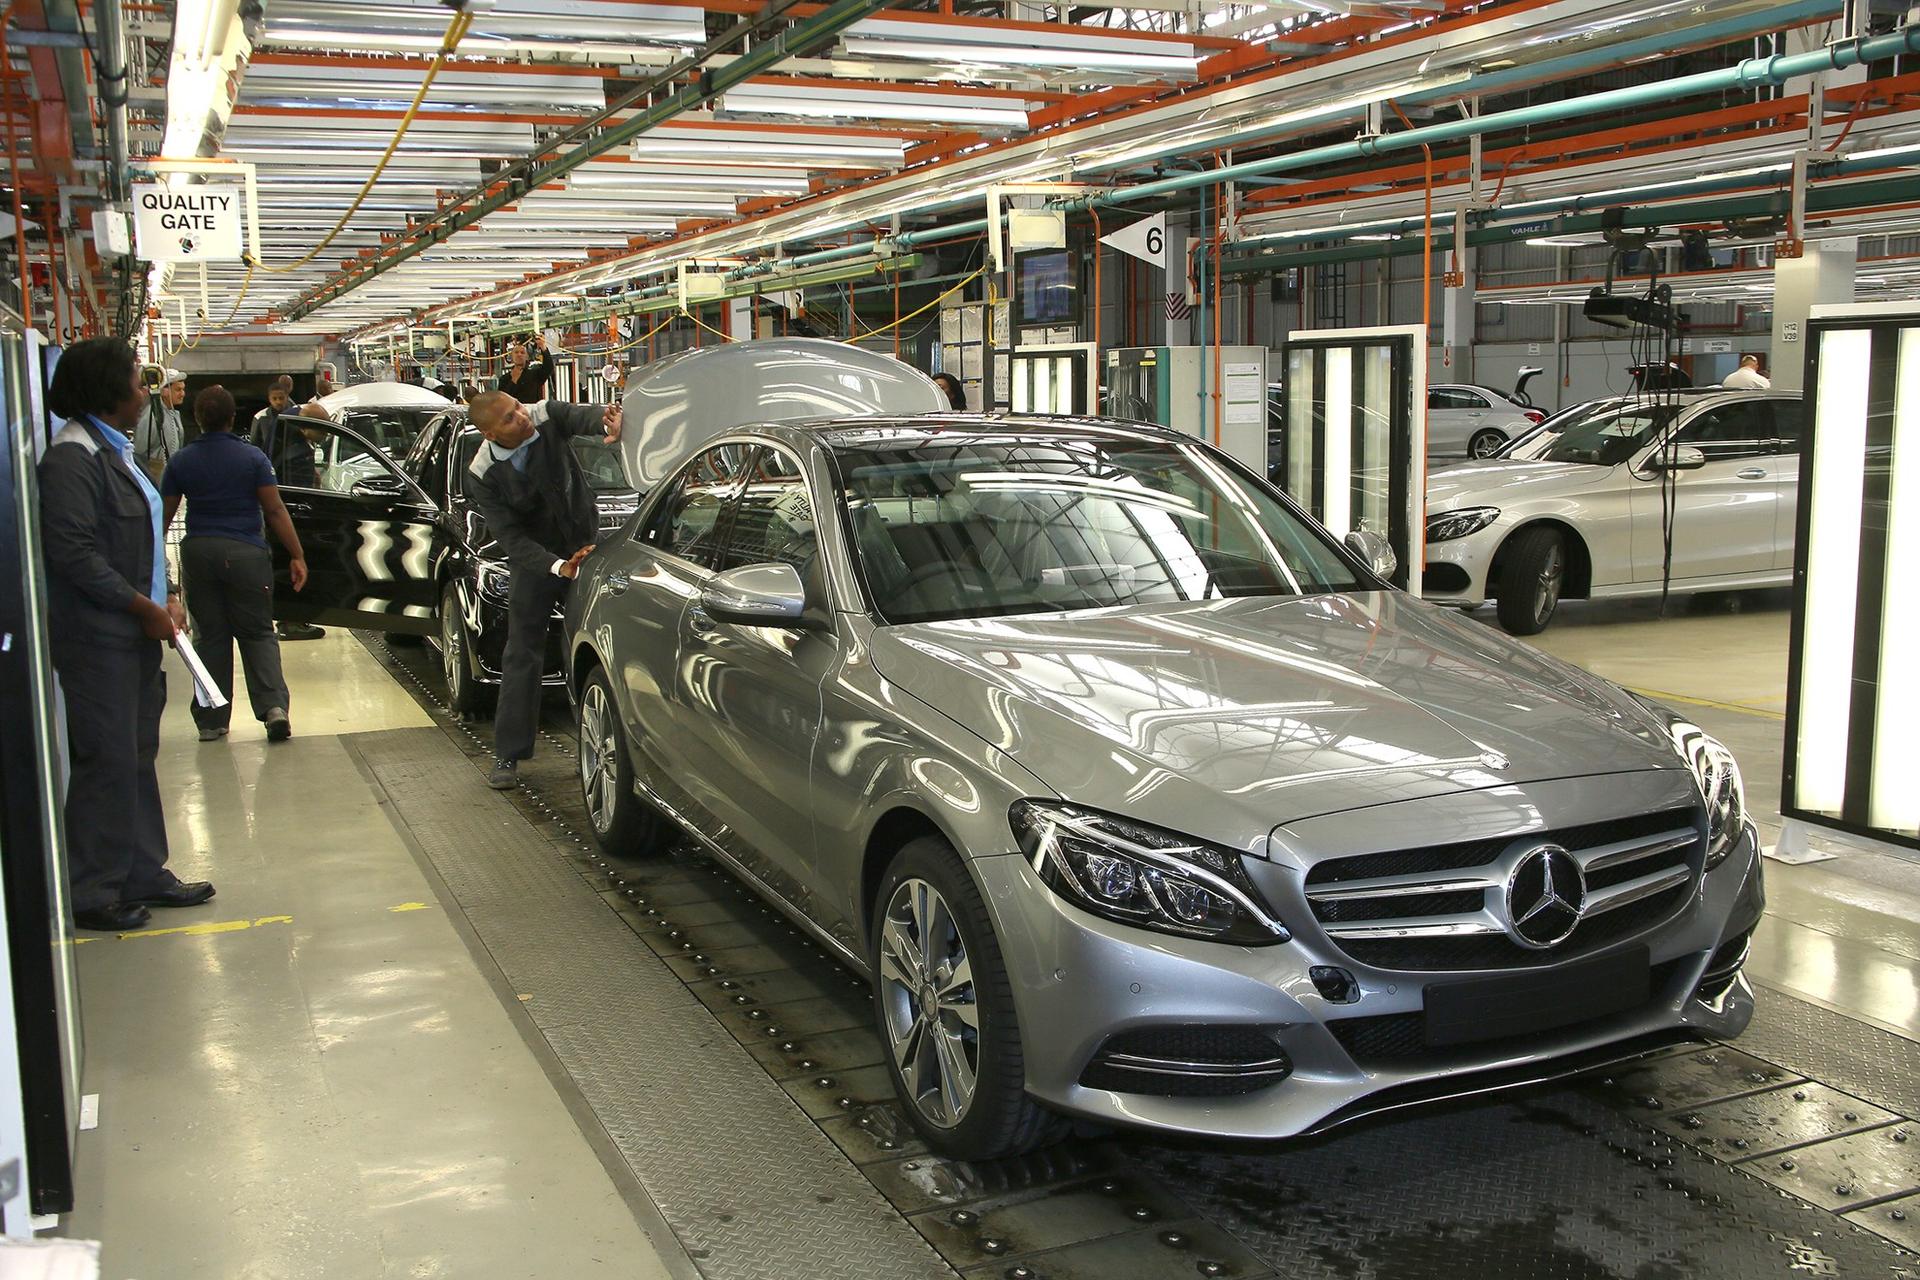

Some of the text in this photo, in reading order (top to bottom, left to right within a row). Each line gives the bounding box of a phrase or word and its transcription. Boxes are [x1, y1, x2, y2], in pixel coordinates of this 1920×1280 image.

[142, 193, 230, 211] QUALITY
[161, 214, 215, 230] GATE
[1511, 225, 1541, 235] VAHLE
[1146, 226, 1163, 255] 6
